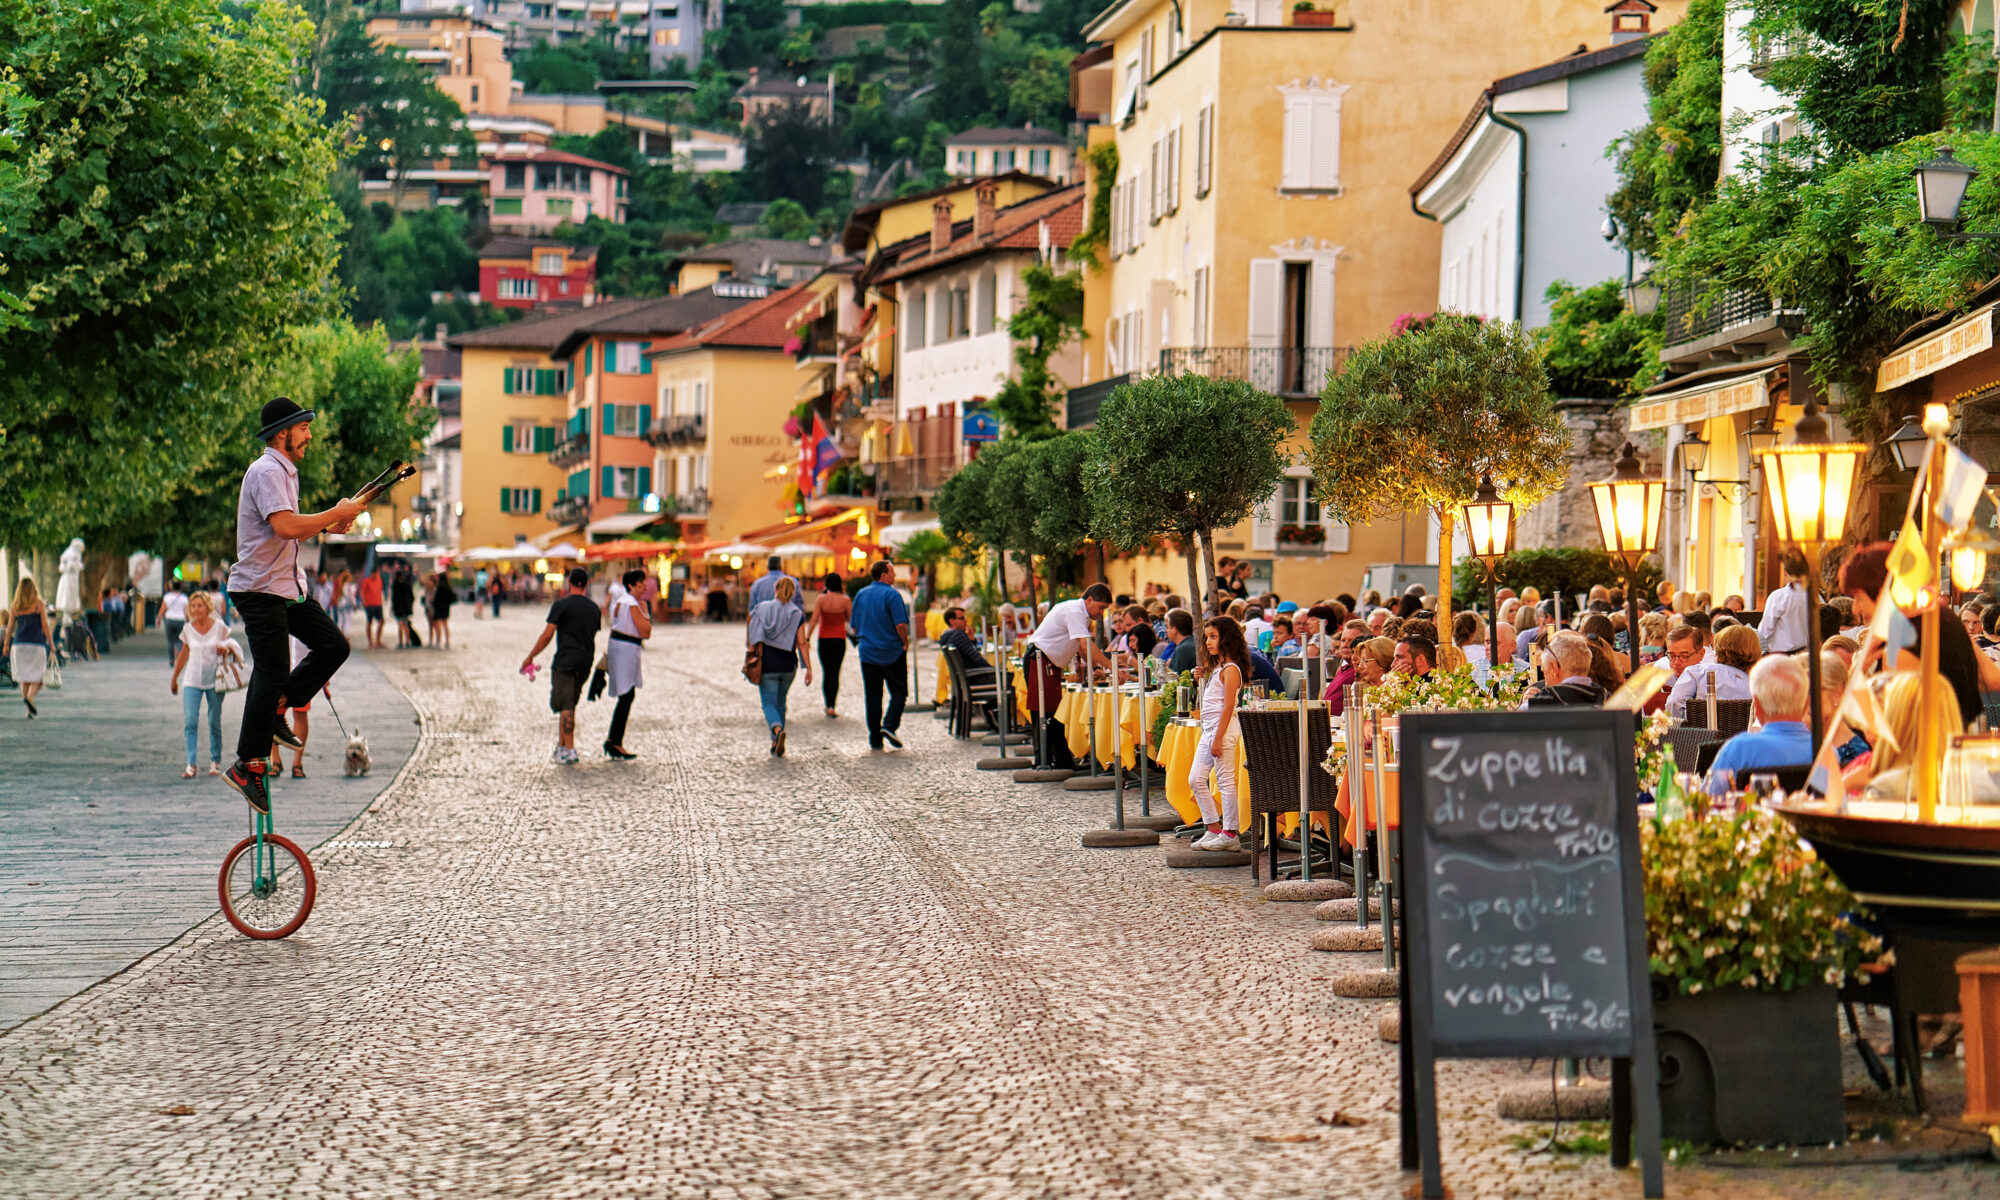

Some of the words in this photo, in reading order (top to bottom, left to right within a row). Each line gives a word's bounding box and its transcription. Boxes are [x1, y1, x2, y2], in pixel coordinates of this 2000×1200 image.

[1427, 736, 1587, 792] Zuppetta
[1433, 787, 1465, 824] di
[1436, 878, 1594, 932] Spaghetti
[1583, 946, 1607, 965] e
